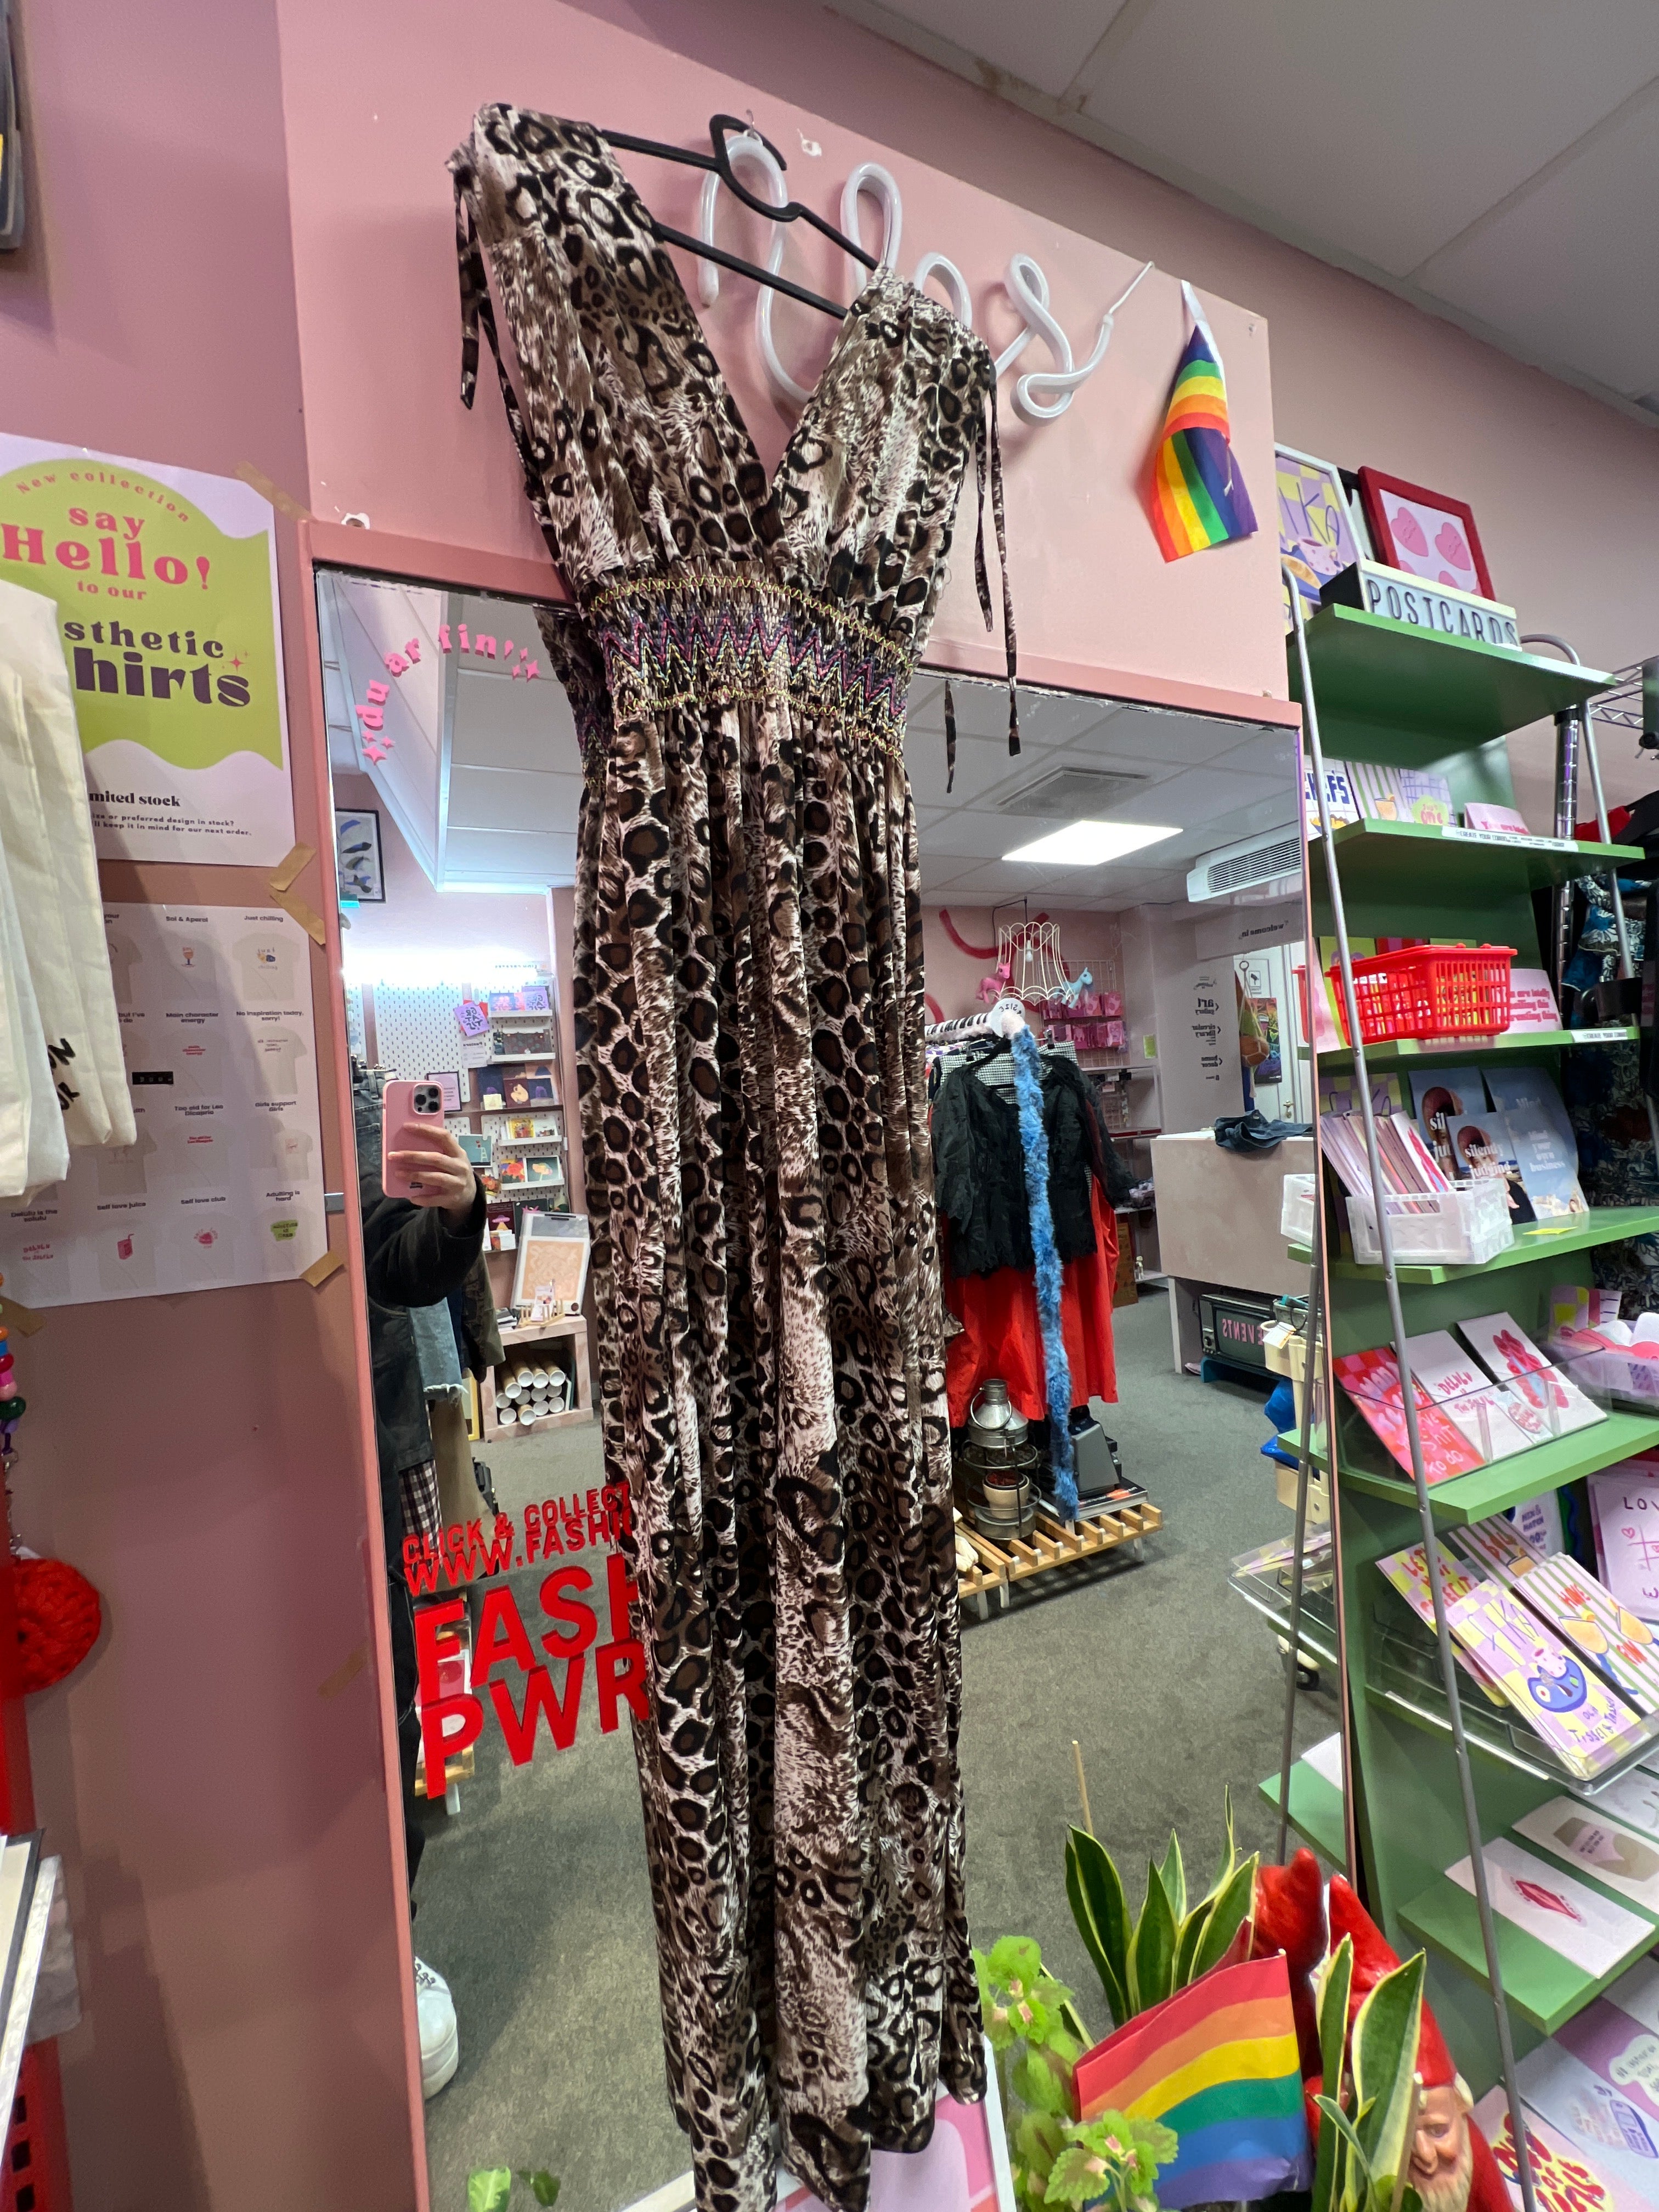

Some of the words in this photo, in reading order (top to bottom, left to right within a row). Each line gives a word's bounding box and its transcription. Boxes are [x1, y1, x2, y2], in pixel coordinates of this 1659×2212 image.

[16, 474, 56, 494] New
[69, 471, 189, 522] collection
[1278, 482, 1340, 545] IKA
[68, 507, 145, 540] say
[1, 523, 210, 590] Hello!
[77, 579, 99, 595] to
[108, 585, 147, 600] our
[1367, 579, 1519, 646] POSTCARDS
[64, 620, 224, 658] sthetic
[74, 646, 251, 707] hirts
[89, 791, 135, 804] mited
[138, 795, 180, 807] stock
[121, 815, 163, 823] preferred
[167, 817, 195, 826] design
[103, 821, 124, 830] keep
[1465, 1142, 1503, 1158] silently
[403, 1517, 483, 1565] CLICK
[494, 1512, 515, 1539] &
[524, 1481, 630, 1530] COLLECT
[420, 1638, 649, 1801] PWR
